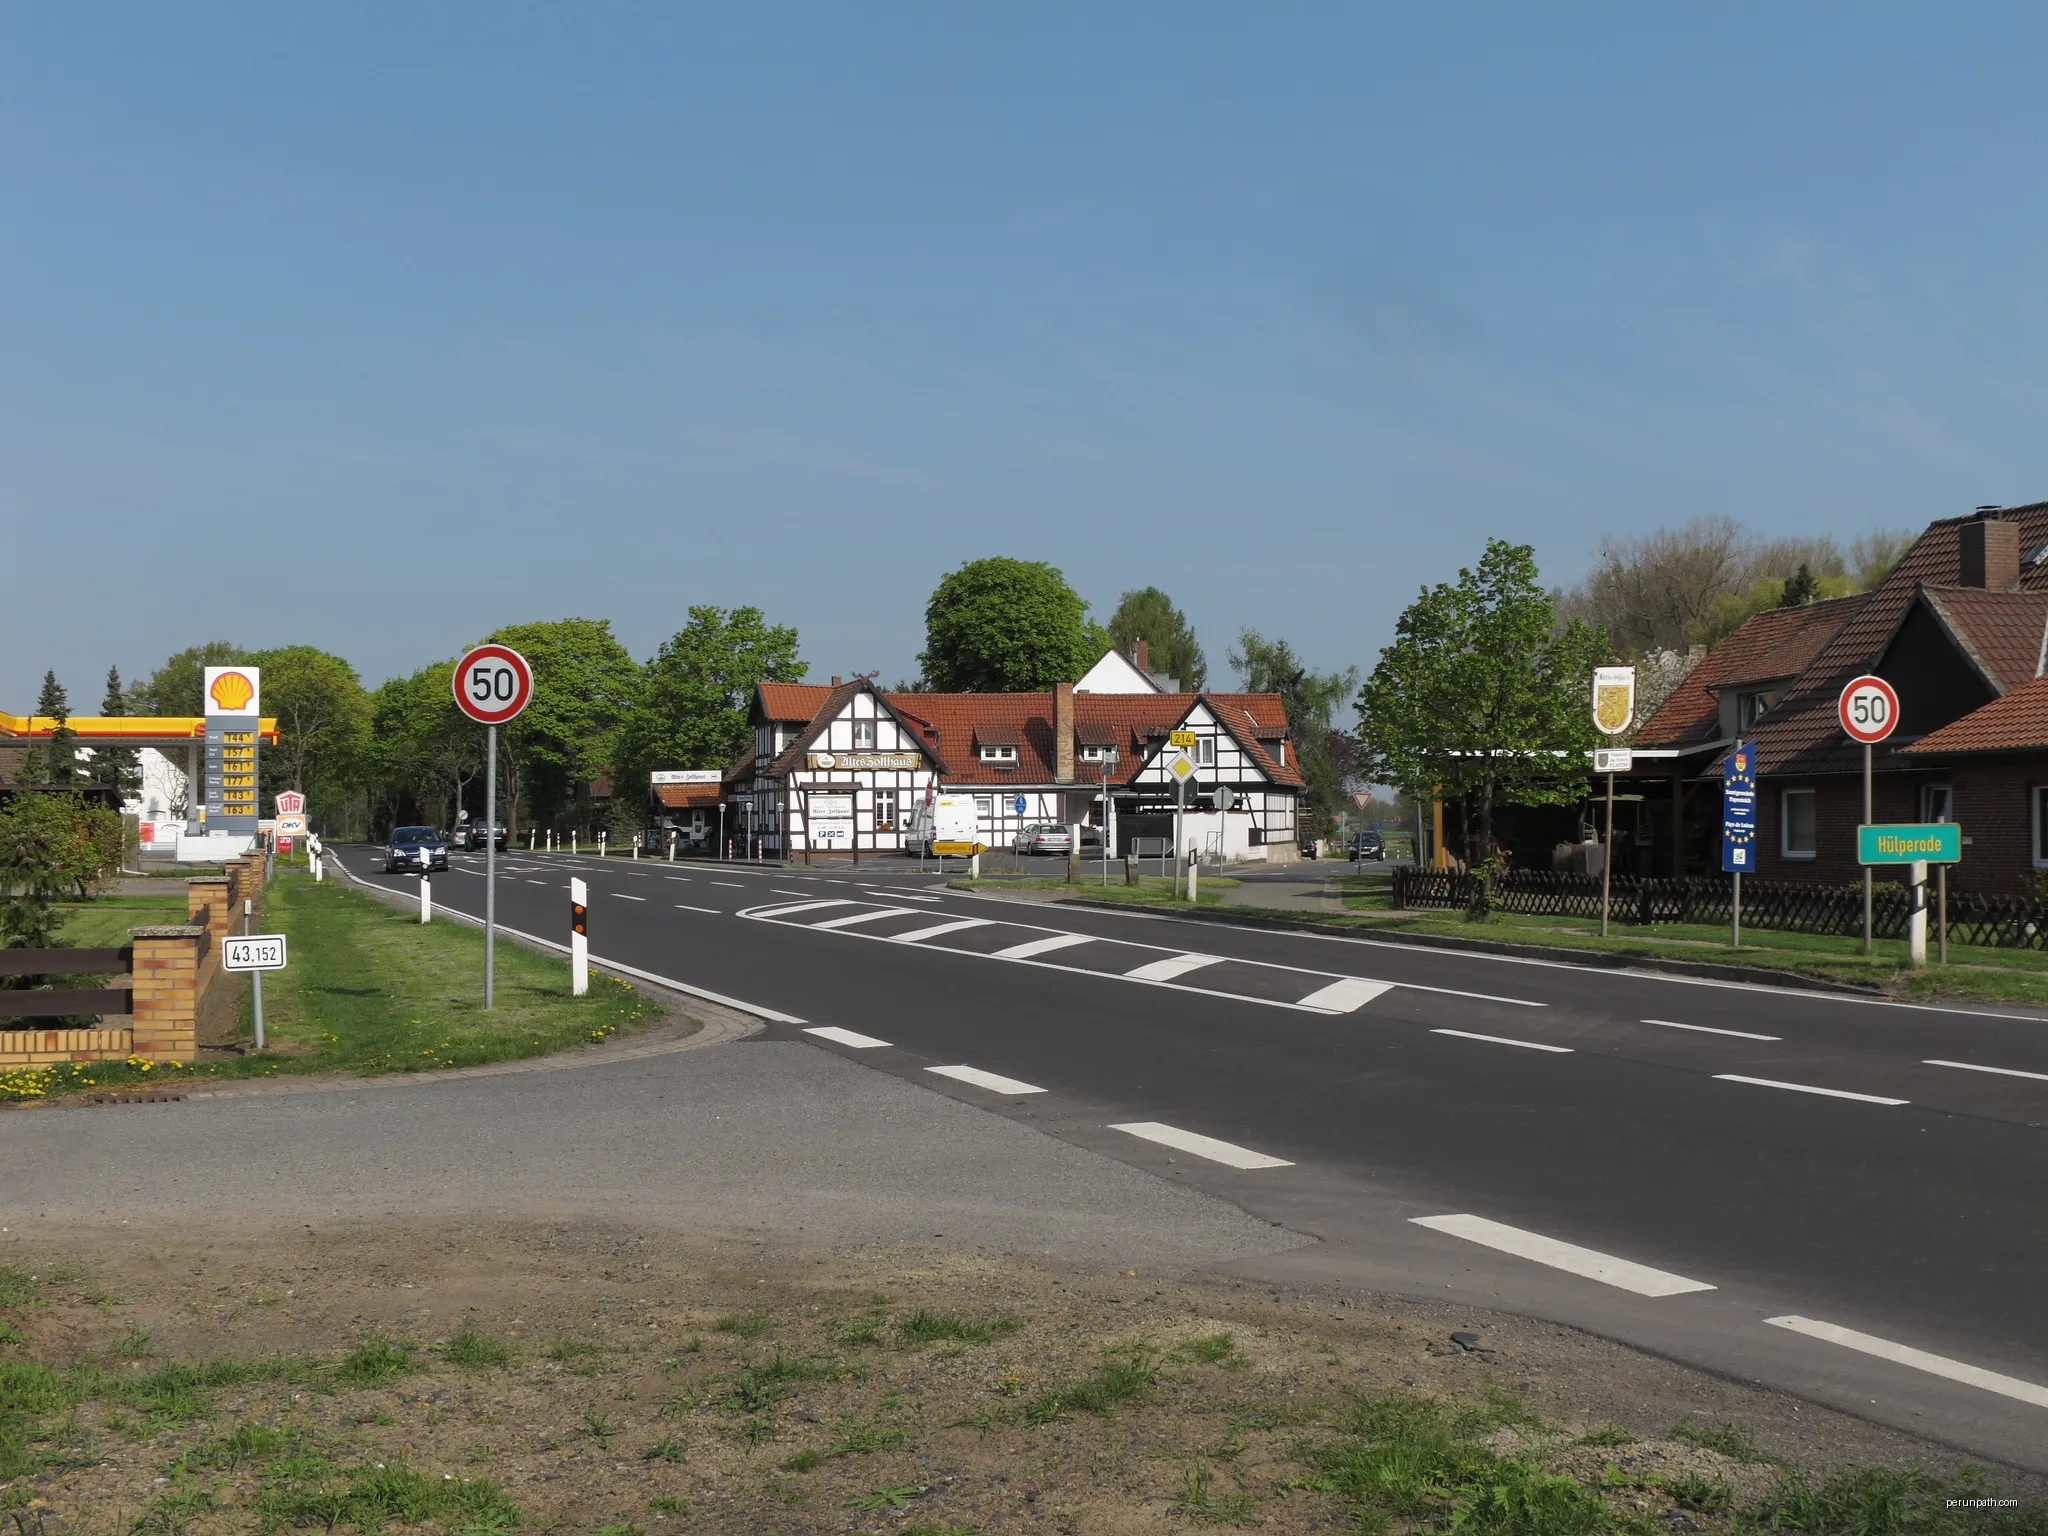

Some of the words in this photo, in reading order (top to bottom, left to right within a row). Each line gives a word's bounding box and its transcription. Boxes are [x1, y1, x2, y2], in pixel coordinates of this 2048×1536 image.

[473, 668, 513, 701] 50
[1854, 696, 1885, 724] 50
[1174, 733, 1191, 743] 214
[840, 756, 866, 767] Altes
[280, 793, 301, 812] UTA
[1878, 836, 1942, 856] Hülperode
